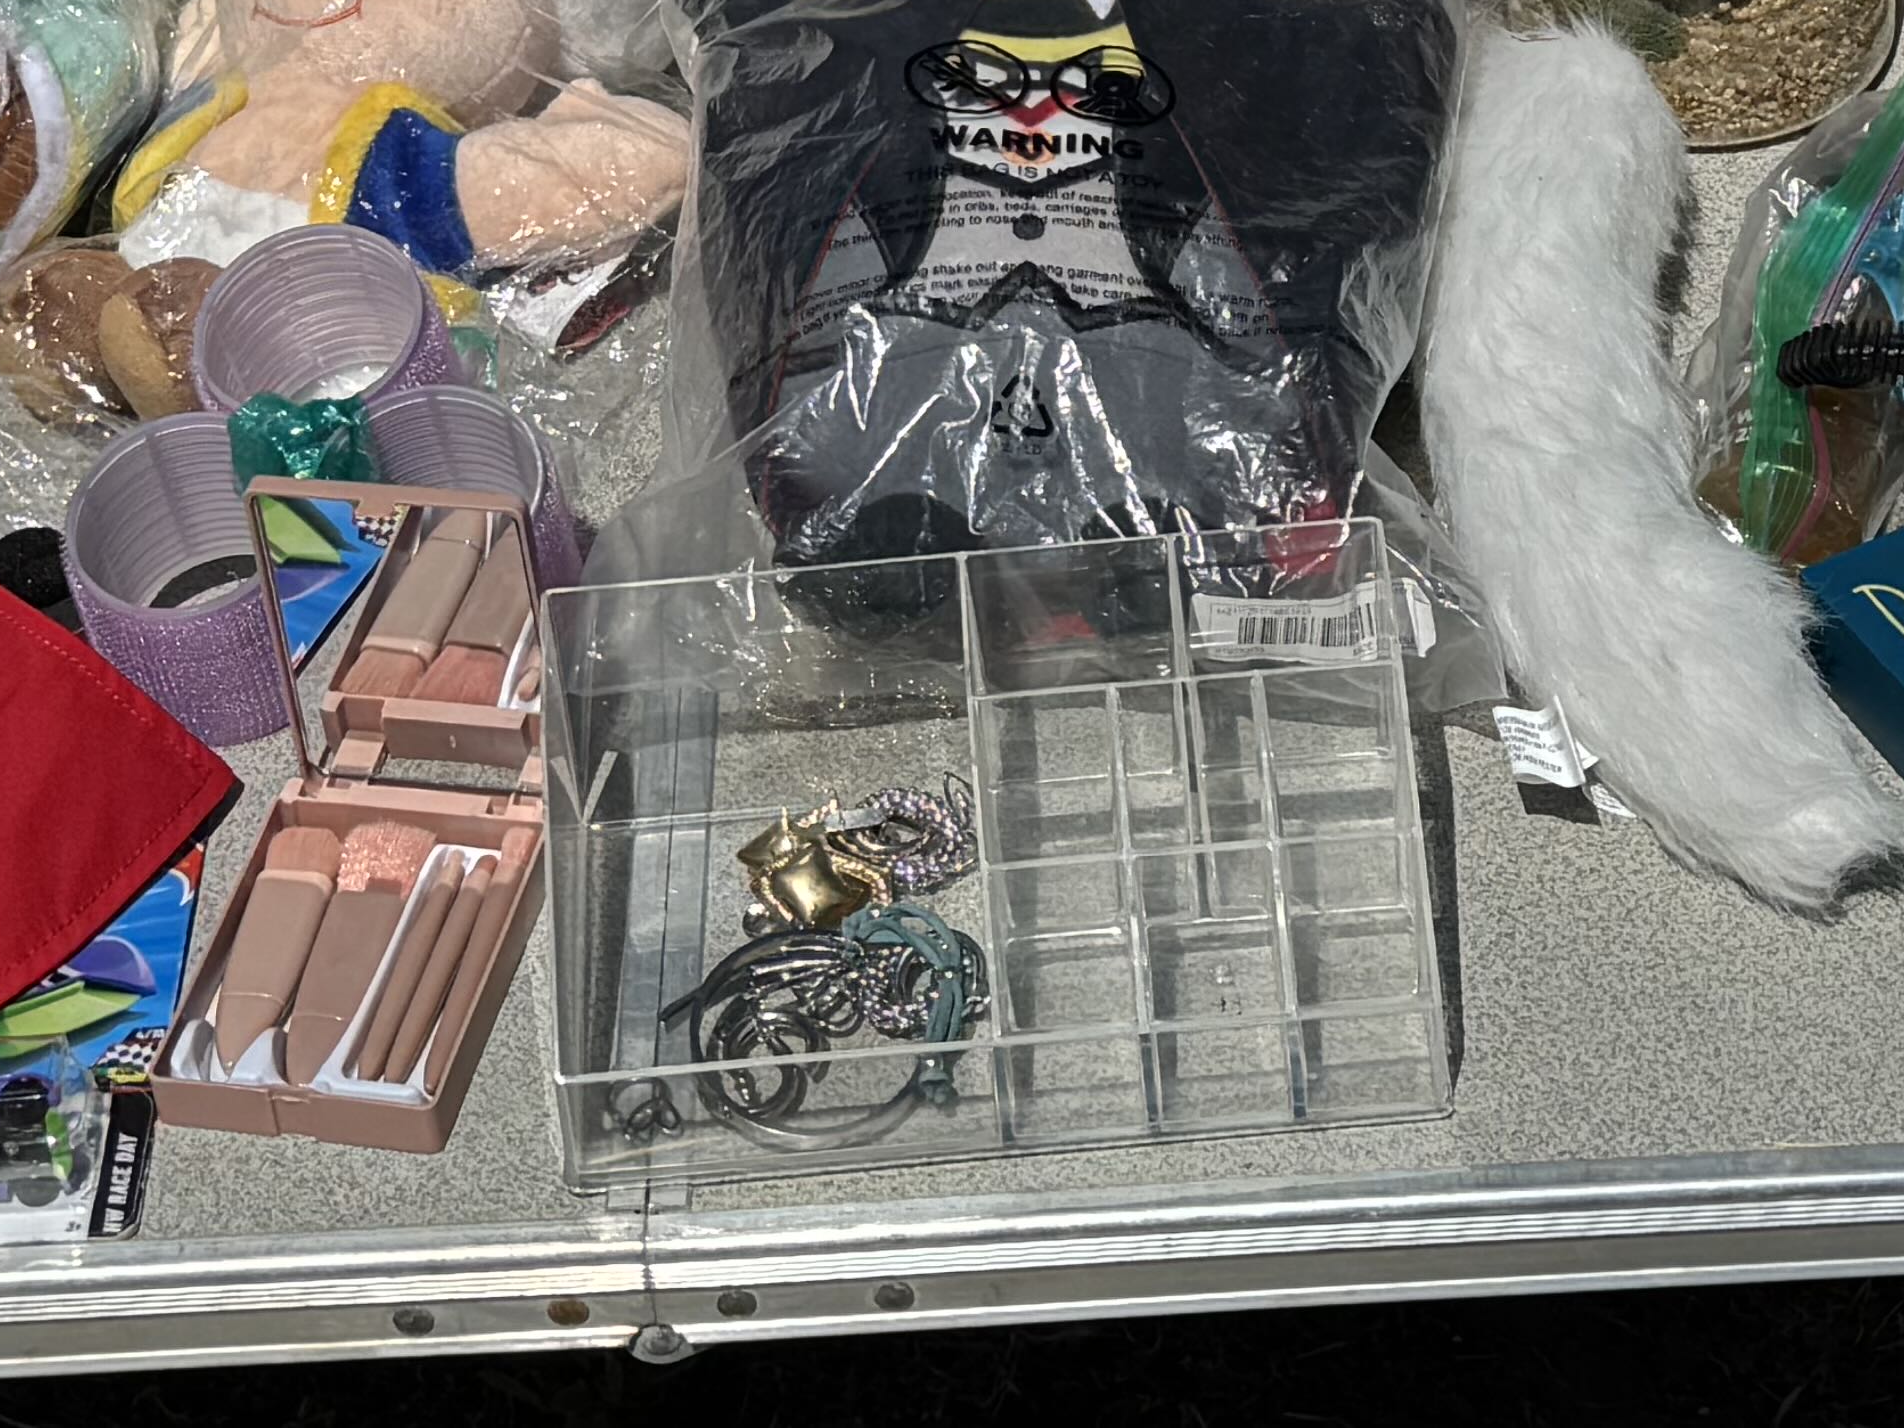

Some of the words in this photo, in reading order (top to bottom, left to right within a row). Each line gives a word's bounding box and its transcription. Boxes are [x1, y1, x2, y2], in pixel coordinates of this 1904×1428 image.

[929, 123, 1146, 161] WARNING
[1016, 163, 1039, 179] IS
[1061, 189, 1077, 201] of
[968, 215, 983, 226] to
[1051, 216, 1095, 229] mouth
[931, 261, 973, 277] shake
[974, 261, 999, 276] out
[1066, 266, 1123, 285] garment
[113, 1131, 139, 1164] DAY
[106, 1165, 134, 1206] RACE
